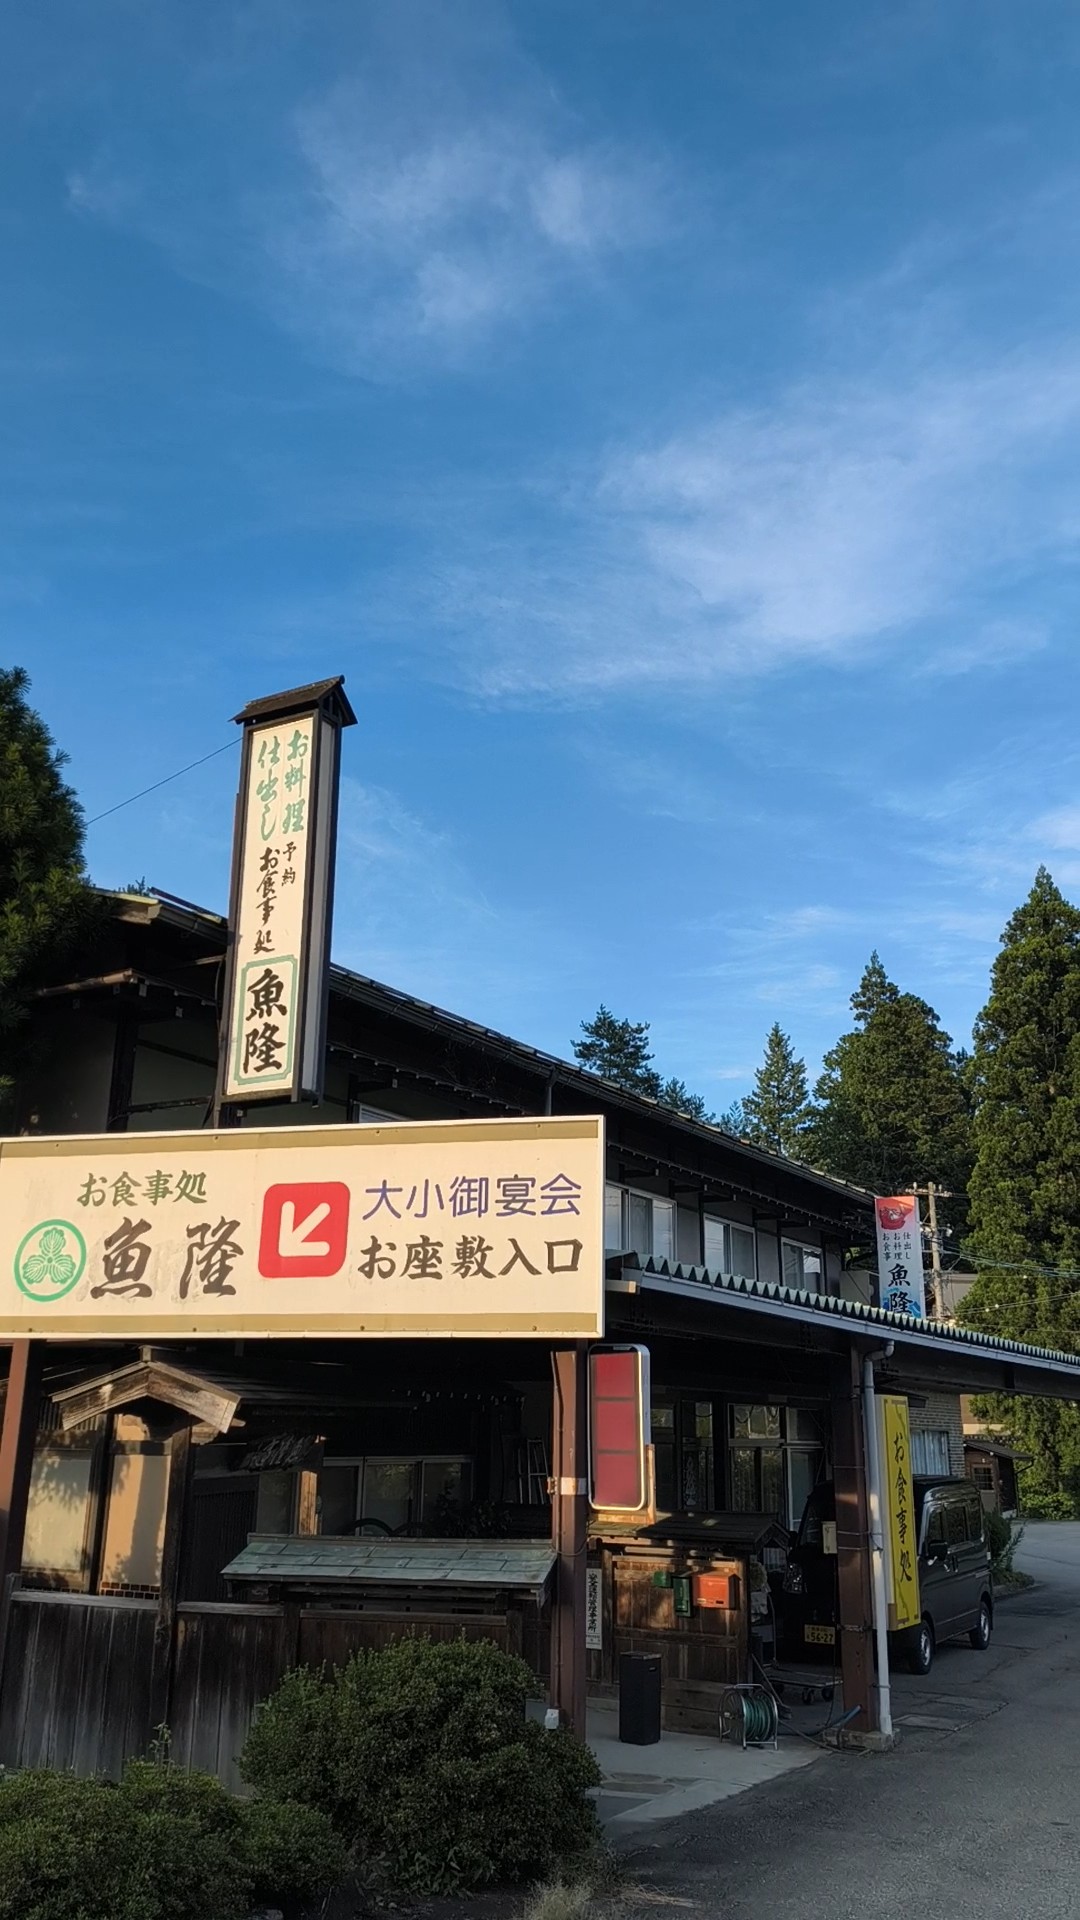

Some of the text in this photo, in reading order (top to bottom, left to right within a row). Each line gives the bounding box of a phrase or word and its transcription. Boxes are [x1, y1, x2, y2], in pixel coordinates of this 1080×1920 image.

[256, 737, 281, 842] 仕出し
[282, 729, 309, 834] お料理
[282, 842, 297, 886] 予約
[254, 847, 281, 954] お食事処
[243, 968, 287, 1075] 魚隆
[77, 1170, 208, 1208] お食事処
[362, 1173, 582, 1220] 大小御宴会
[90, 1216, 244, 1300] 魚隆
[357, 1234, 583, 1280] お座敷入口
[882, 1232, 891, 1261] お食事
[893, 1232, 903, 1261] お料理
[903, 1232, 912, 1260] 仕出し
[888, 1263, 913, 1314] 魚隆
[893, 1431, 912, 1583] お食事処
